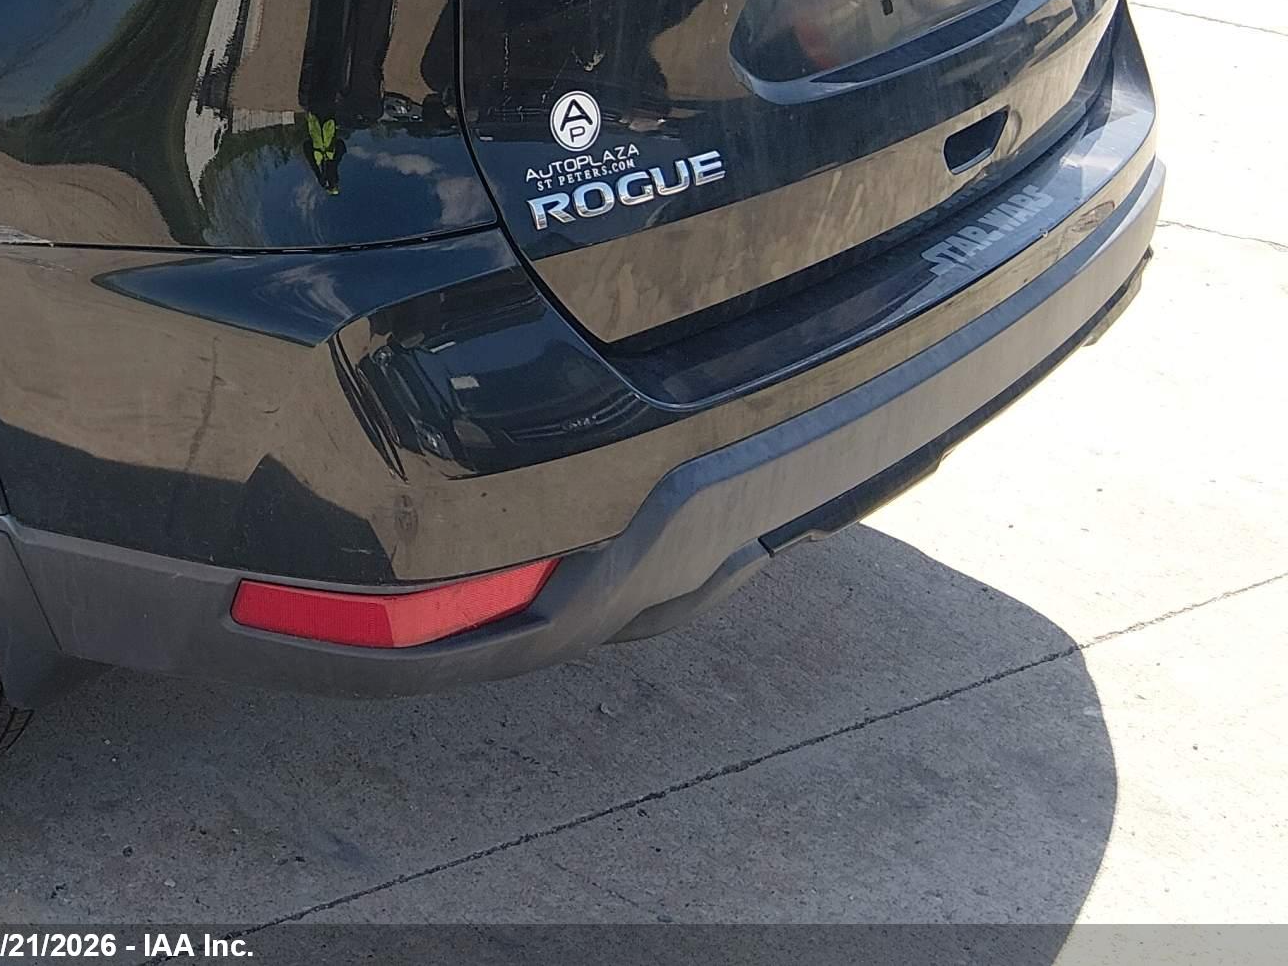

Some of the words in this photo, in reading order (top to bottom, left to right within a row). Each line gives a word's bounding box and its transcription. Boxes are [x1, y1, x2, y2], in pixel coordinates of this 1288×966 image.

[525, 142, 640, 183] AUTOPLAZA
[526, 150, 727, 231] ROGUE
[536, 179, 553, 192] ST
[558, 158, 636, 187] PETERS.COM
[921, 225, 1006, 277] STAR
[977, 184, 1054, 231] WARS
